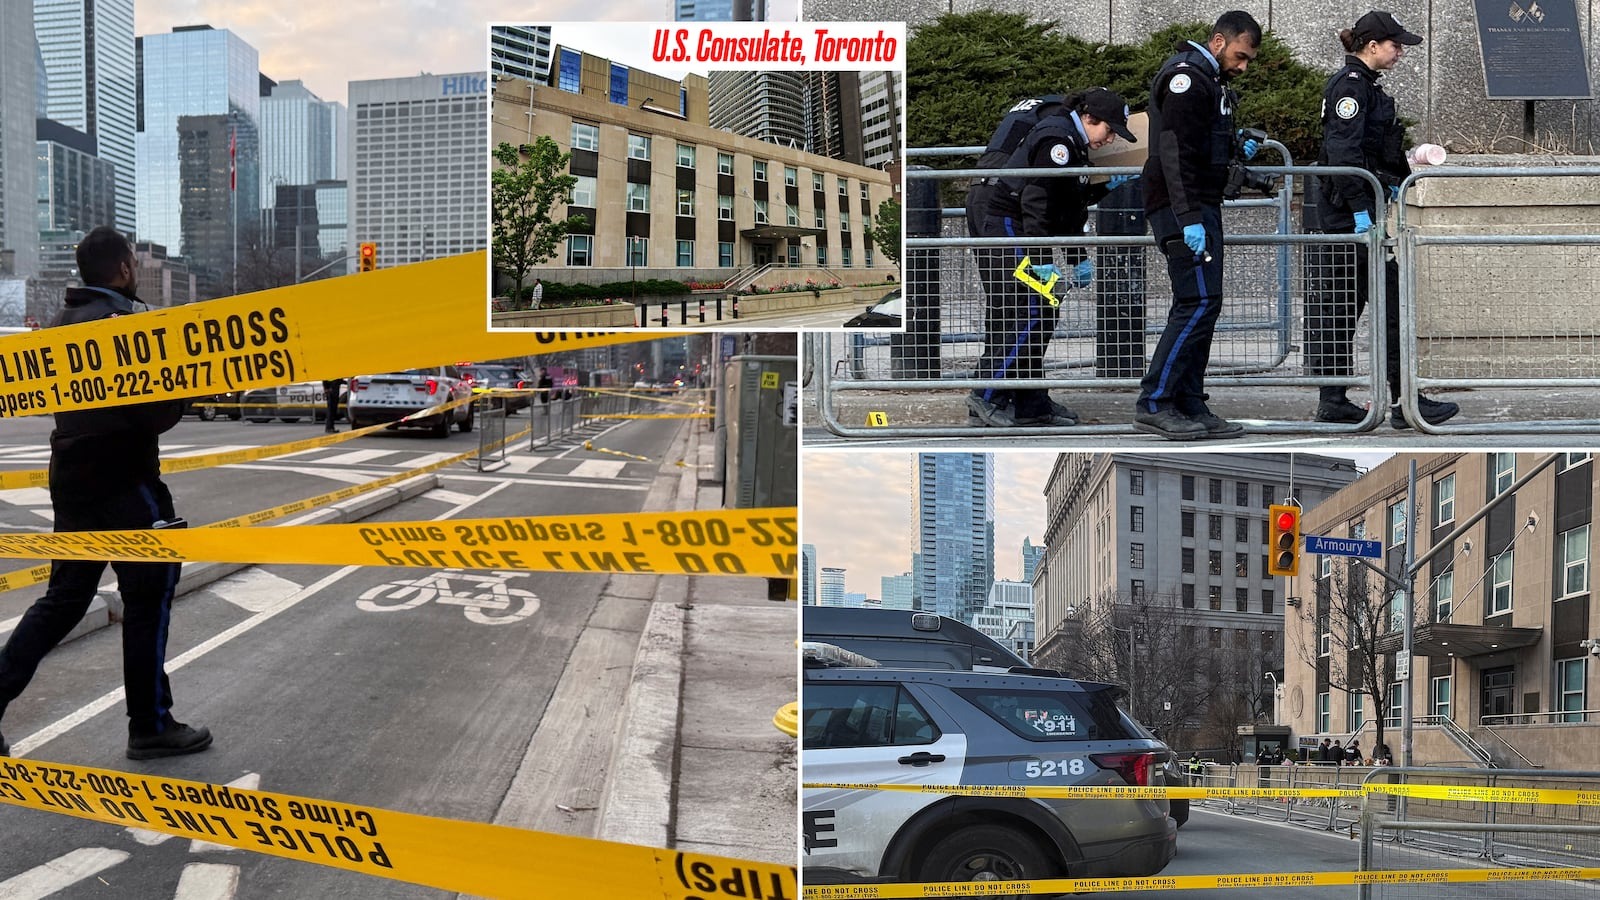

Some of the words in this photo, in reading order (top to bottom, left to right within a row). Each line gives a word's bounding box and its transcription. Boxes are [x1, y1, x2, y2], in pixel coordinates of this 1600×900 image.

[0, 347, 57, 383] LINE
[66, 339, 103, 374] DO
[113, 328, 167, 367] NOT
[183, 307, 289, 357] CROSS
[51, 361, 213, 406] 1-800-222-8477
[223, 349, 295, 390] (TIPS)
[876, 414, 883, 425] 6
[1315, 538, 1363, 555] Armoury
[1366, 541, 1374, 549] St
[1025, 758, 1085, 778] 5218
[32, 787, 96, 814] NOT
[100, 797, 149, 823] DO
[161, 782, 282, 821] Stoppers
[153, 805, 239, 840] LINE
[288, 800, 378, 837] Crime
[244, 820, 394, 869] POLICE
